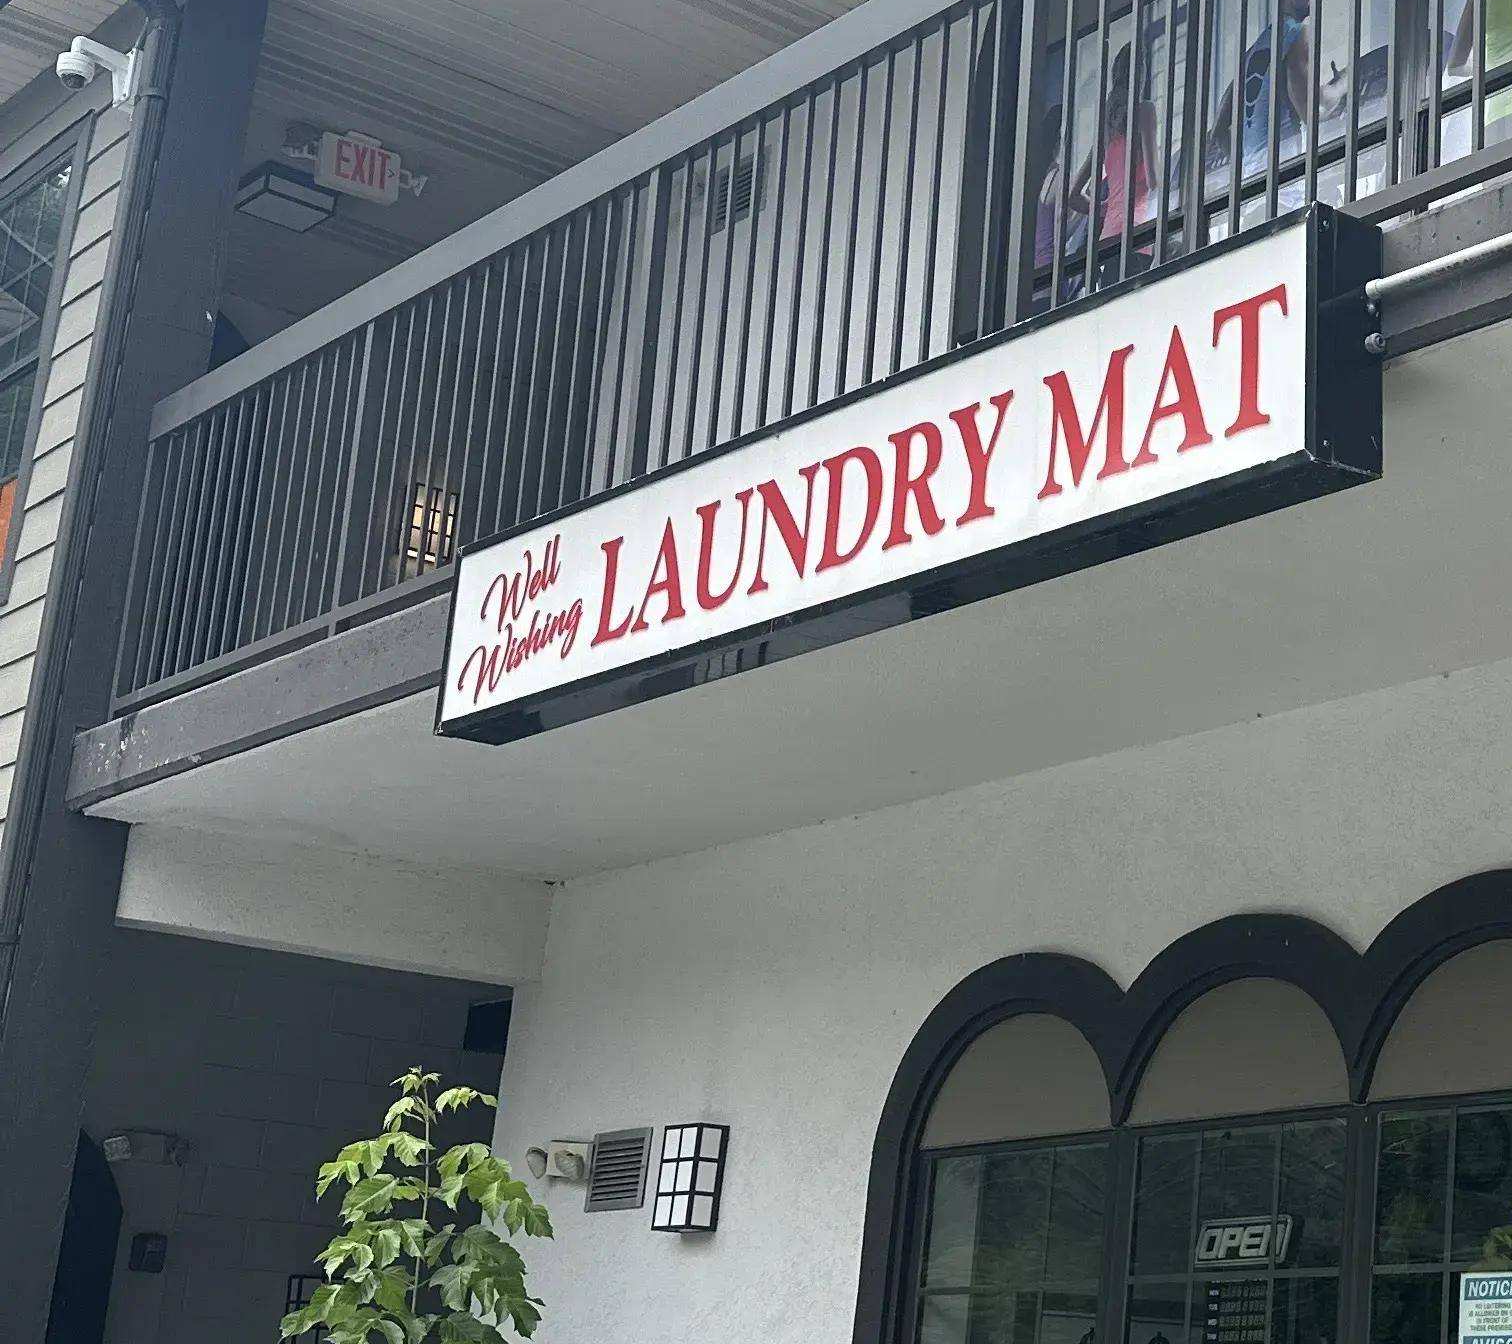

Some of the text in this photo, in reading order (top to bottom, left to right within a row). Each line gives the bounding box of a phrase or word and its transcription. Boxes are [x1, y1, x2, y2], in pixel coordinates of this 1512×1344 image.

[335, 139, 391, 190] EXIT
[591, 283, 1288, 648] LAUNDRY MAT
[480, 533, 561, 633] Well
[457, 598, 583, 704] Wishing
[1199, 1224, 1286, 1259] OPEN
